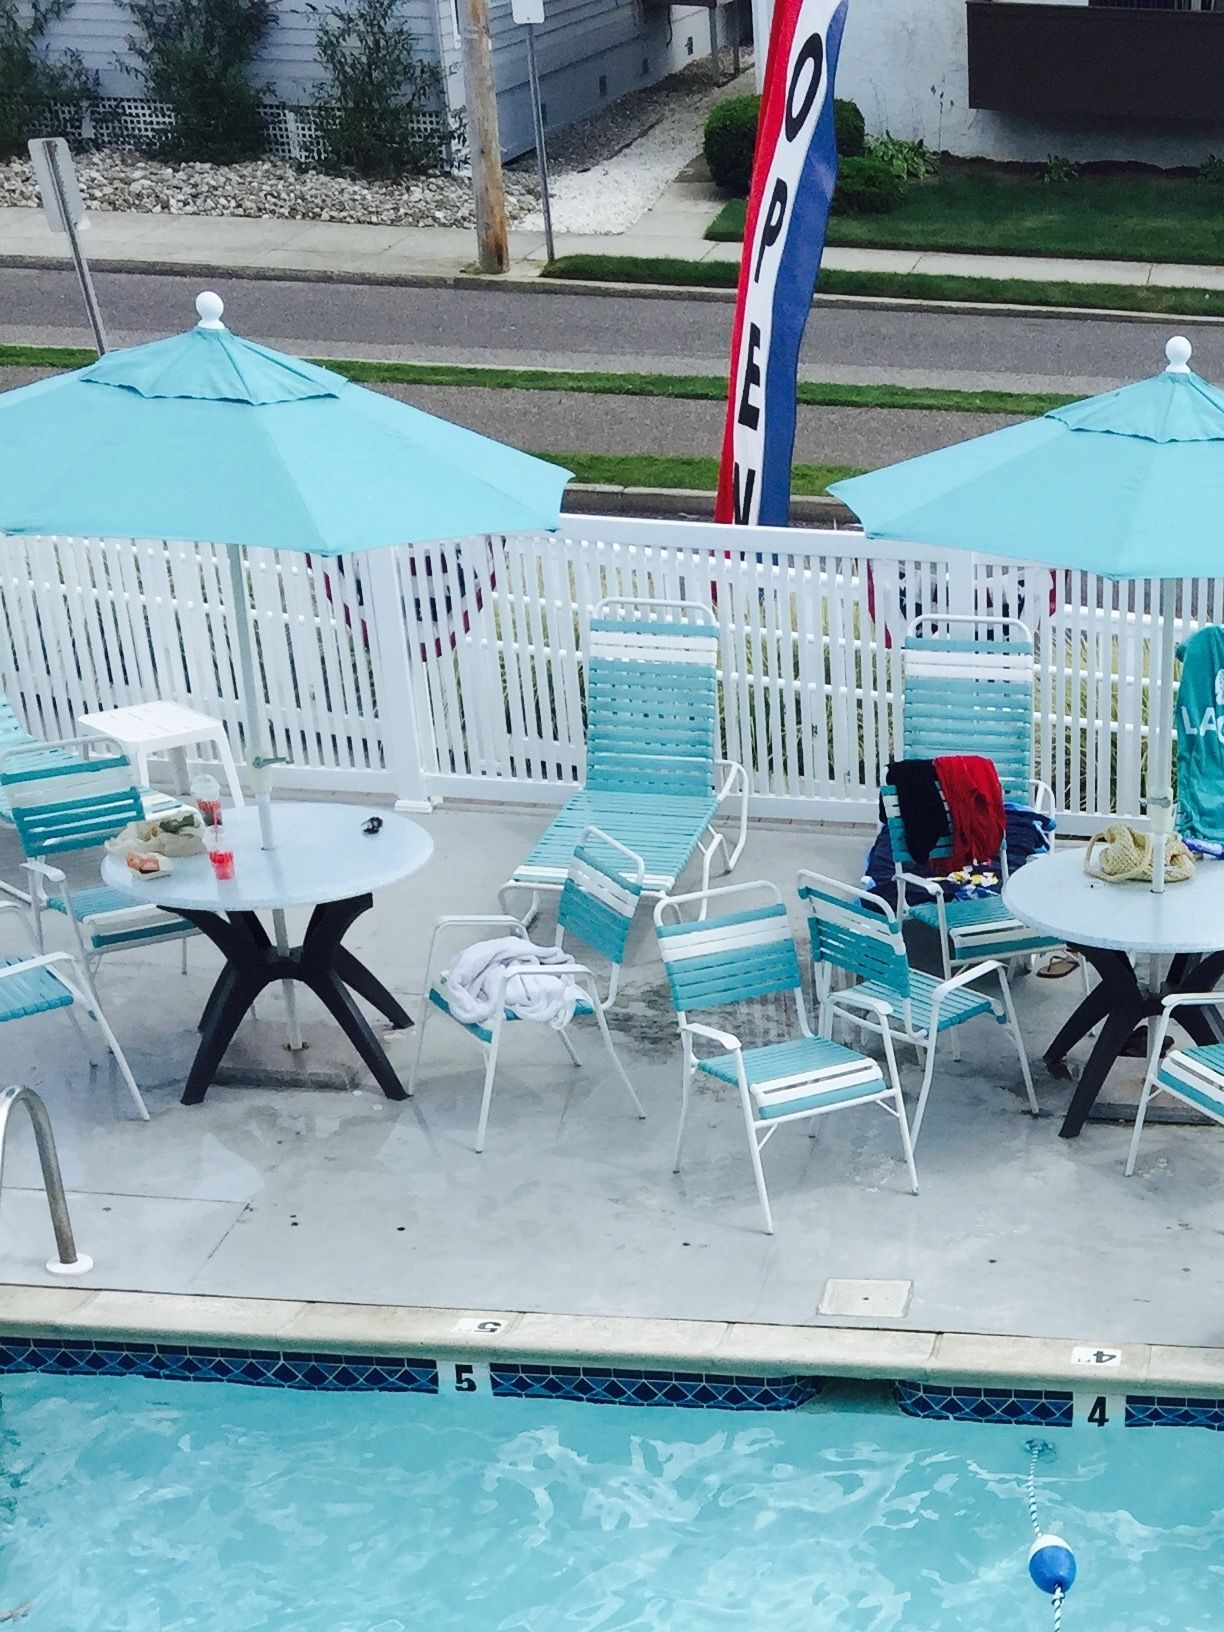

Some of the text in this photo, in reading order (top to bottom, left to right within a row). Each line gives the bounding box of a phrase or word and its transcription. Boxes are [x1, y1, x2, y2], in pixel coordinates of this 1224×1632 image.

[1092, 1351, 1116, 1363] 4
[455, 1364, 477, 1391] 5
[1087, 1396, 1109, 1427] 4
